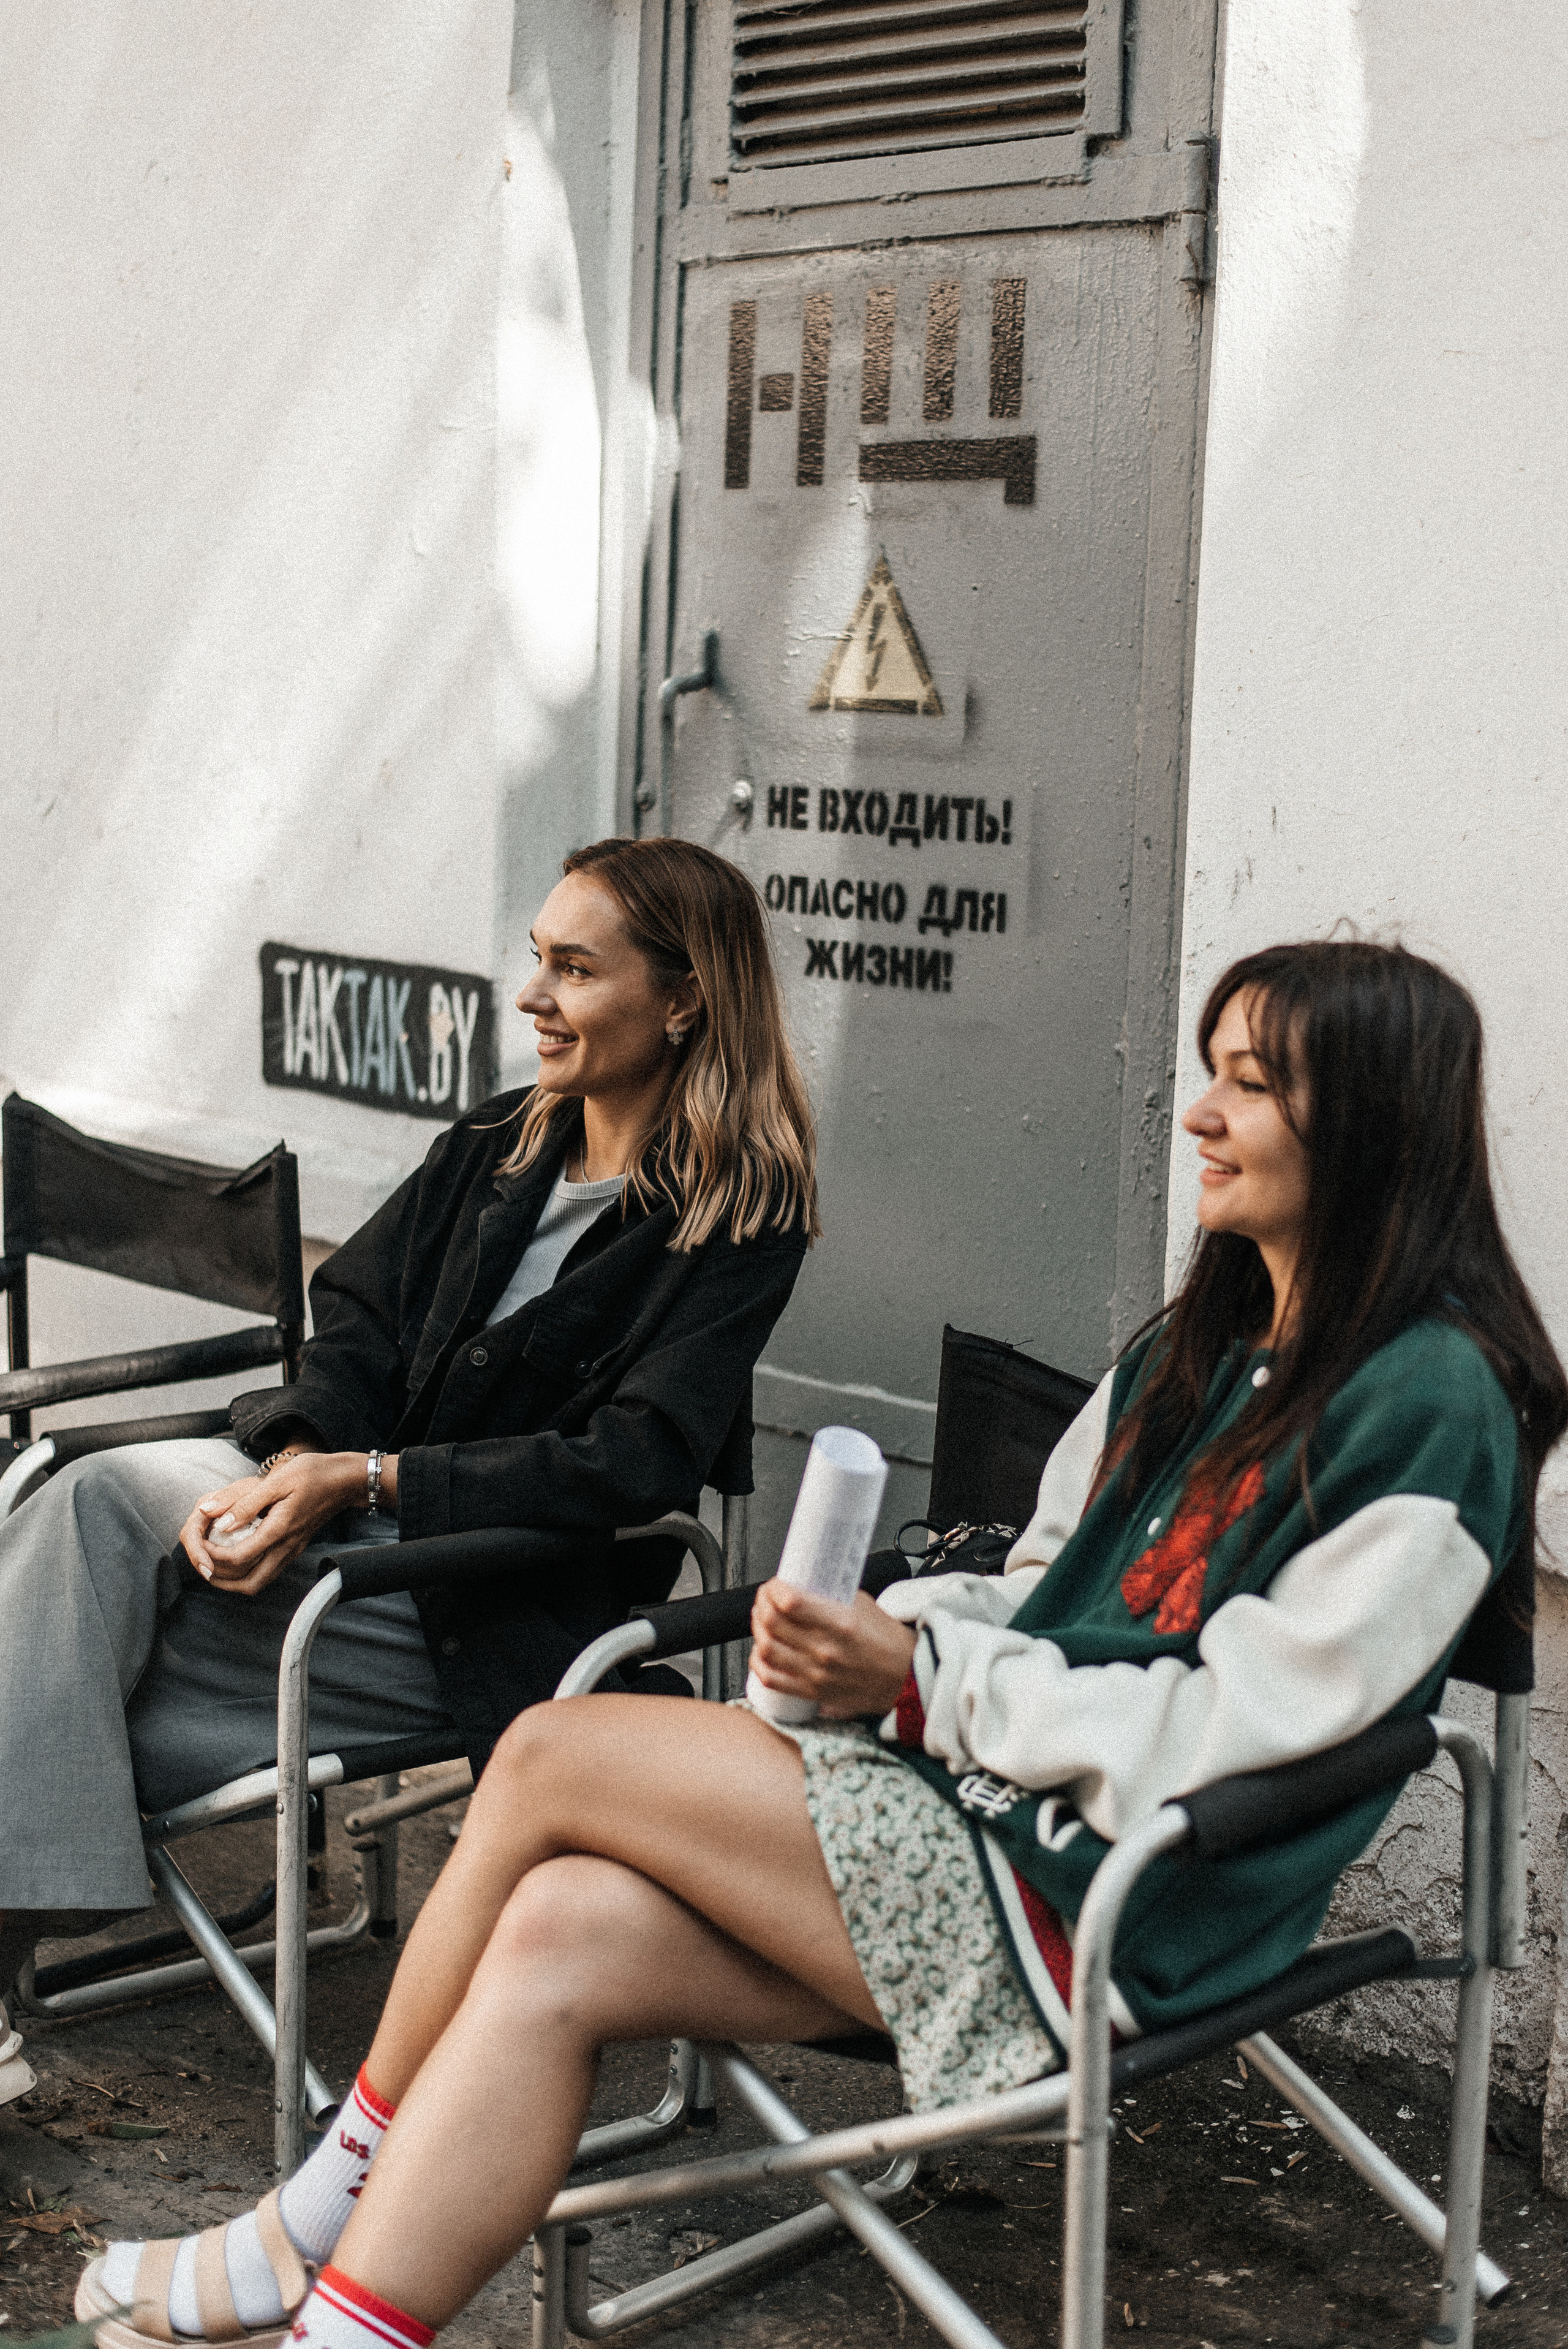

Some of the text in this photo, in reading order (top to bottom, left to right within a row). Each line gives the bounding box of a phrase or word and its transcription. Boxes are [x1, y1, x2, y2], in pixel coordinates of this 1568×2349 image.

[767, 785, 1012, 849] НЕ ВХОДИТЬ!
[764, 873, 1008, 937] ОПАСНО ДЛЯ
[804, 937, 954, 993] ЖИЗНИ!
